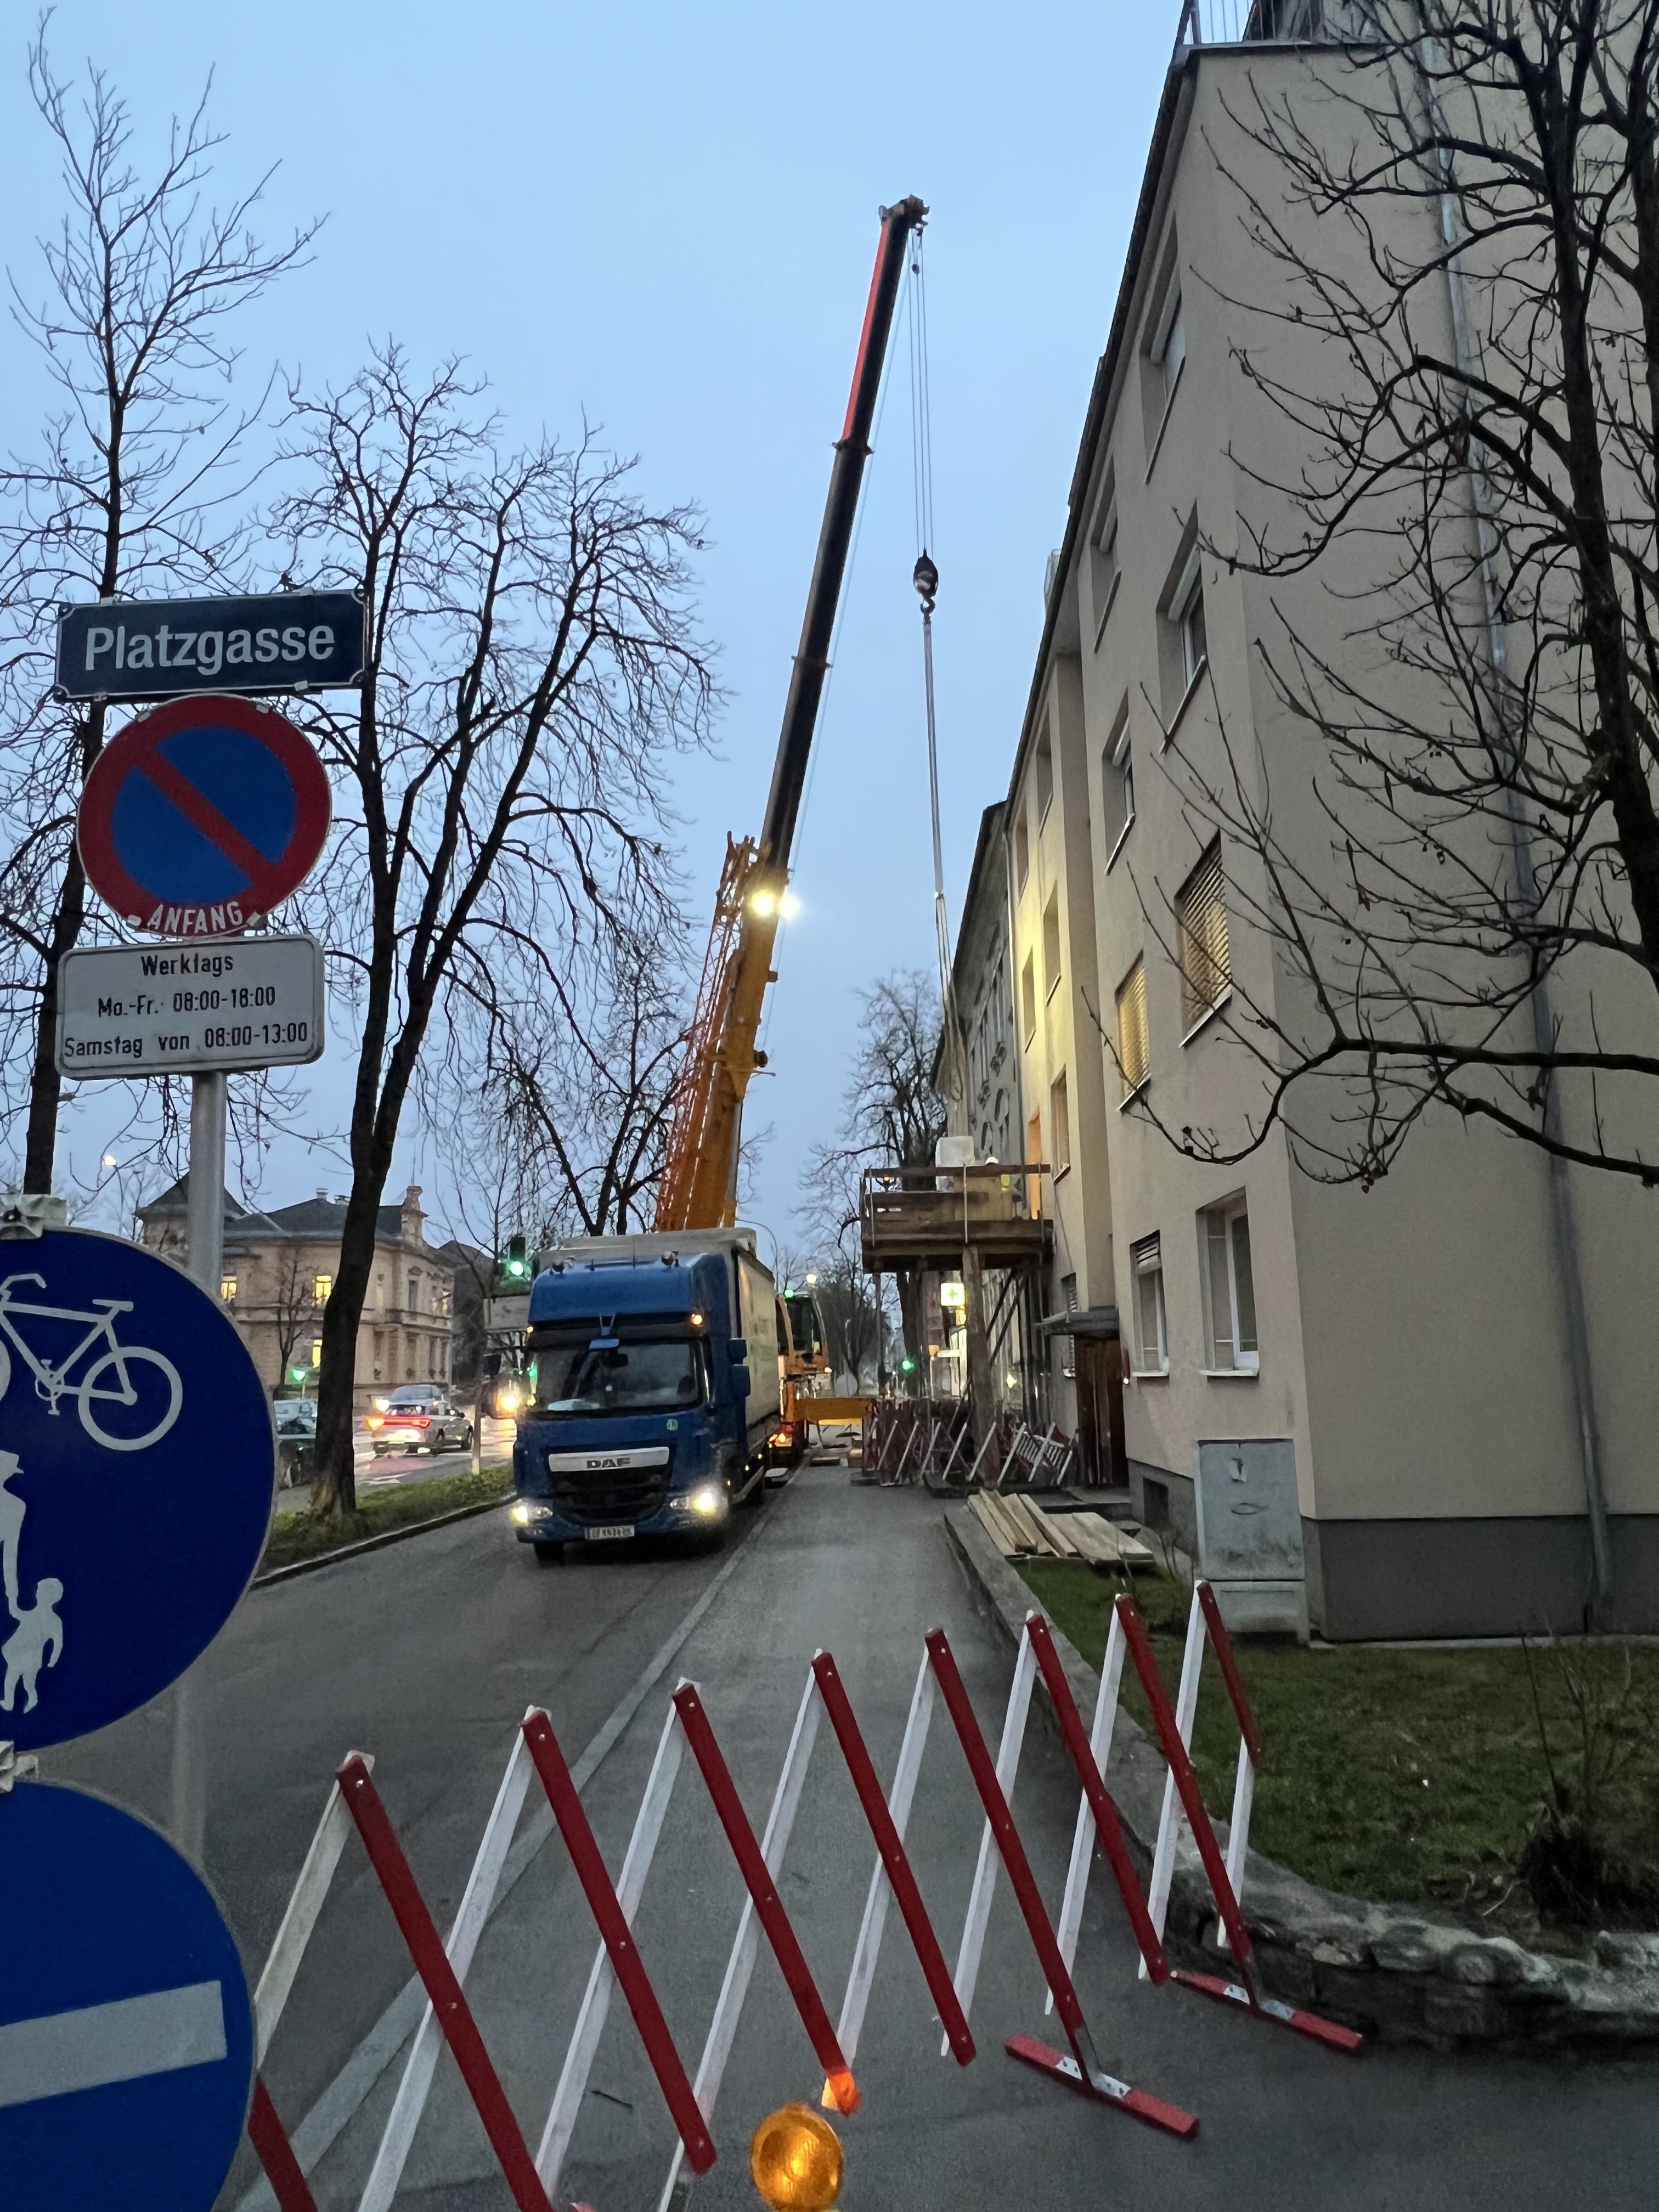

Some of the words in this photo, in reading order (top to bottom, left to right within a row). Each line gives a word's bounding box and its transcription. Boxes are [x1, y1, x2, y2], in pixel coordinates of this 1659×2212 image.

[84, 625, 335, 676] Platzgasse
[146, 901, 243, 933] ANFANG
[140, 953, 234, 977] Werktags
[172, 986, 275, 1012] 08:00-18:00
[64, 1035, 143, 1058] Samstag
[158, 1035, 190, 1052] von
[204, 1022, 308, 1049] 08:00-13:00
[586, 1458, 630, 1469] DAF
